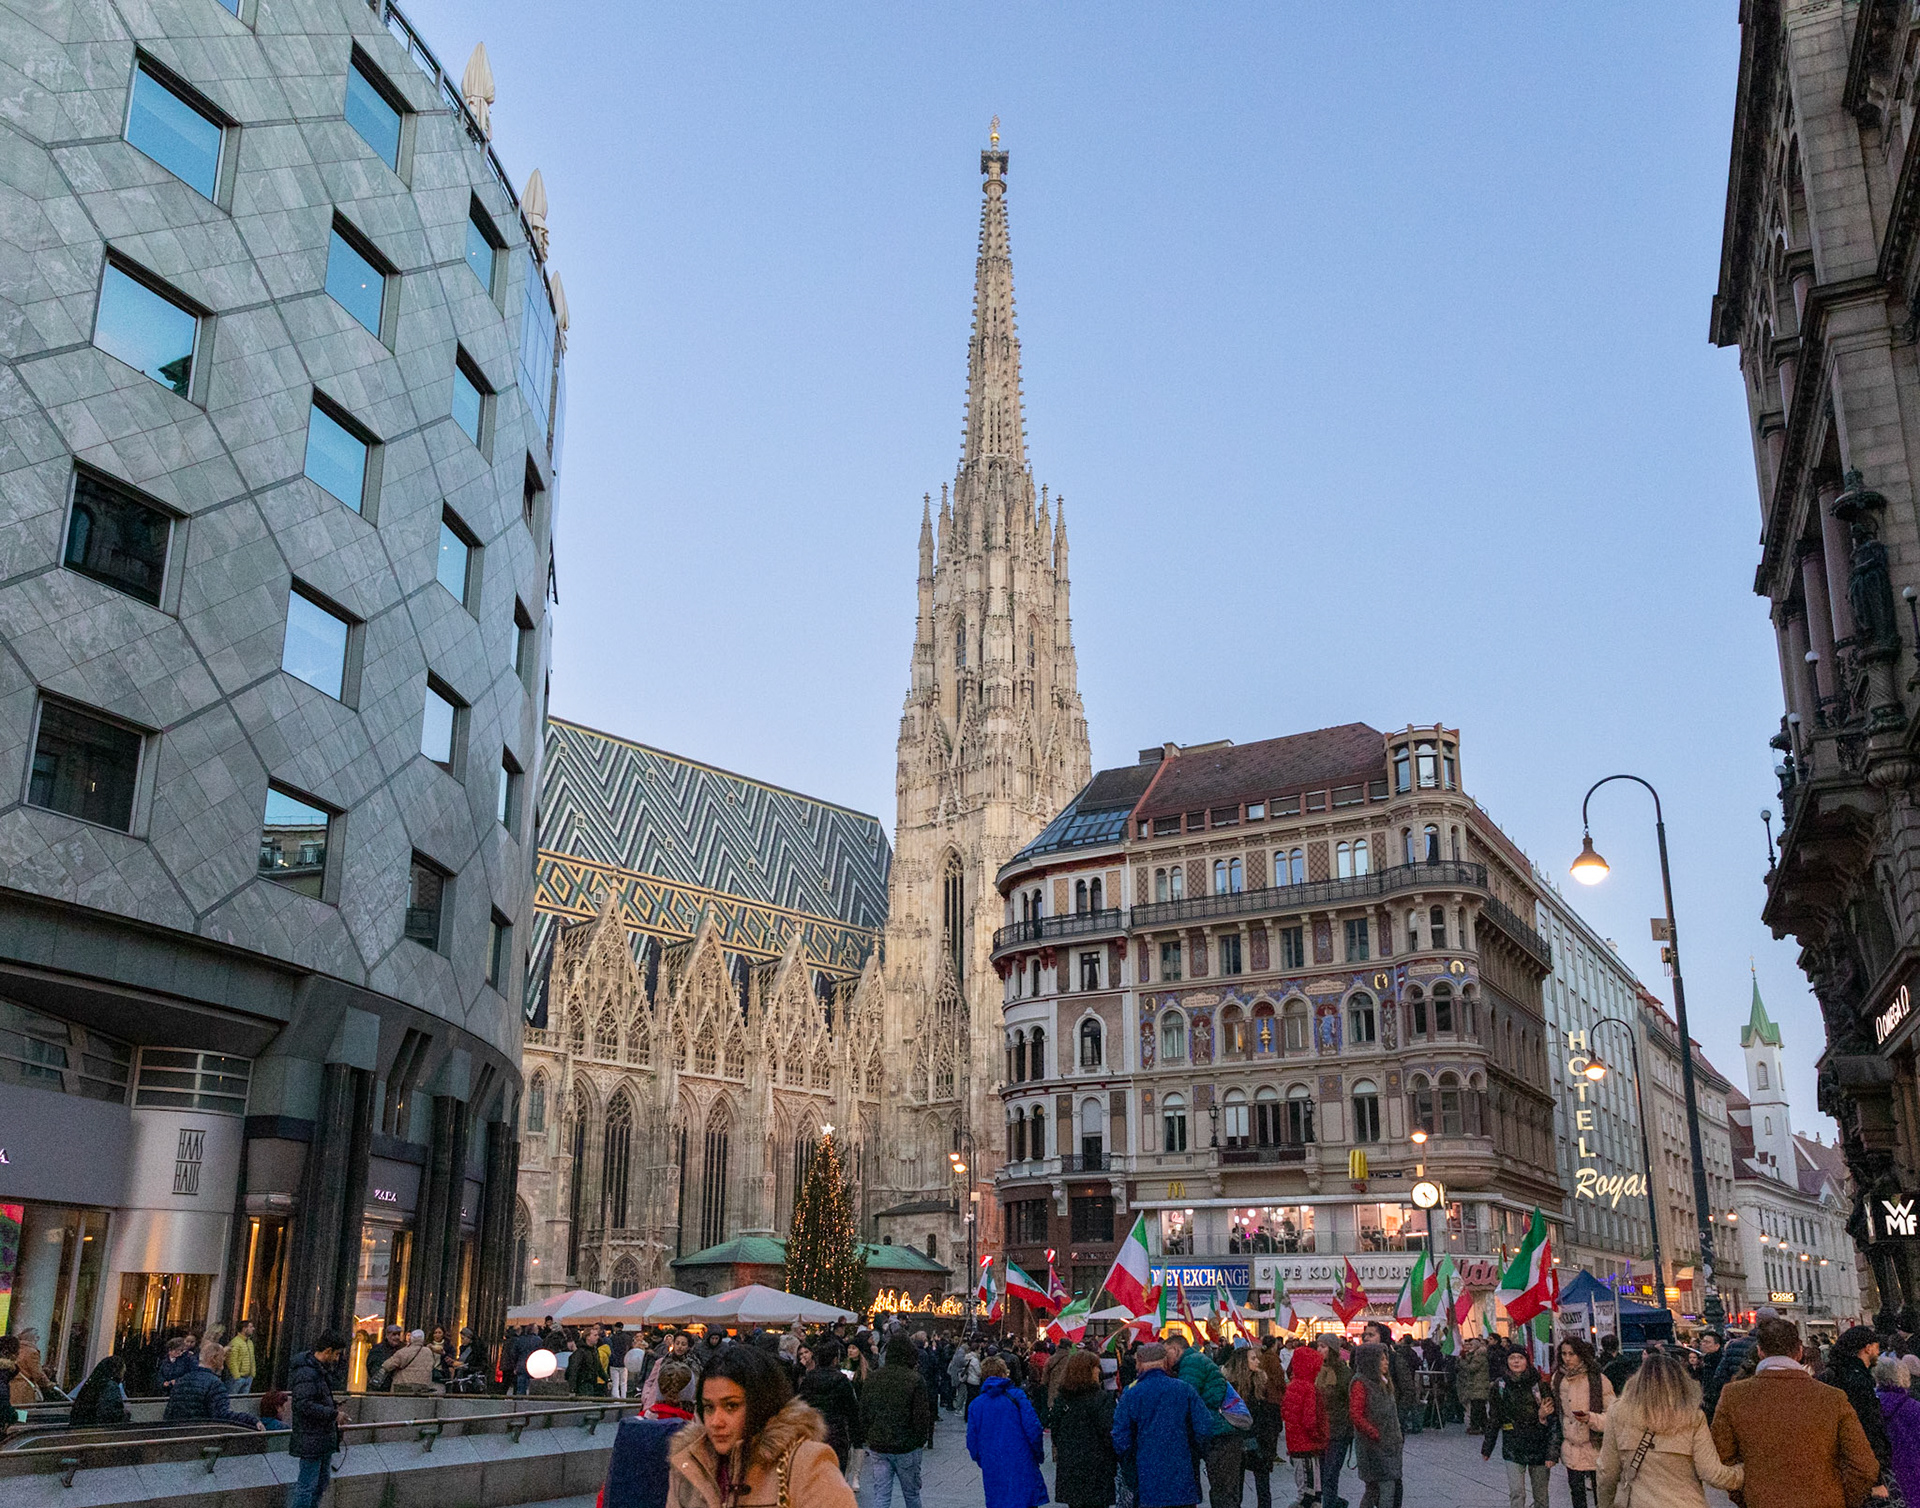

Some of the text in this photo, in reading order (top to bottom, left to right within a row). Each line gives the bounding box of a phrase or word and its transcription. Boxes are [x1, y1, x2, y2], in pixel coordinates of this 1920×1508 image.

[1882, 997, 1903, 1037] OMEGA
[1568, 1030, 1596, 1158] HOTEL
[177, 1130, 206, 1160] HAAS
[173, 1163, 201, 1193] HAUS
[1881, 1199, 1918, 1236] WMF
[1183, 1268, 1250, 1287] EXCHANGE
